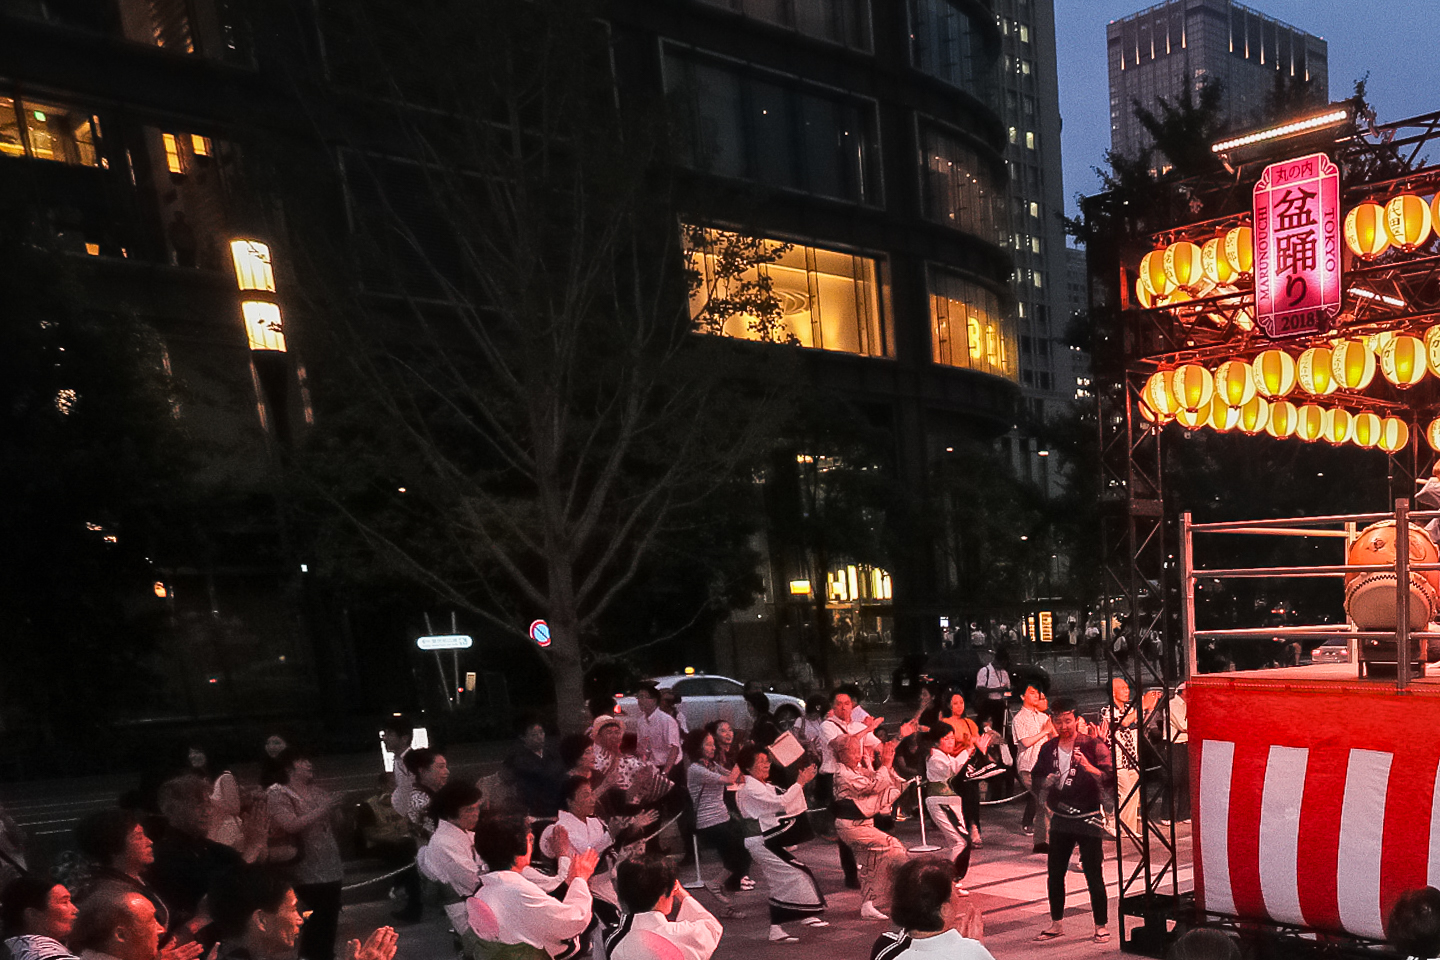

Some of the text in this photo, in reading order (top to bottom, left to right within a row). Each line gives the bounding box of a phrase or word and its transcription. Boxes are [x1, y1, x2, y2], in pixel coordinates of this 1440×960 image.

[1276, 162, 1313, 183] 丸の内
[1258, 206, 1269, 301] MARUNOUCHI
[1273, 186, 1318, 307] 盆踊り
[1324, 207, 1336, 272] TOKYO
[1281, 312, 1316, 331] 2018
